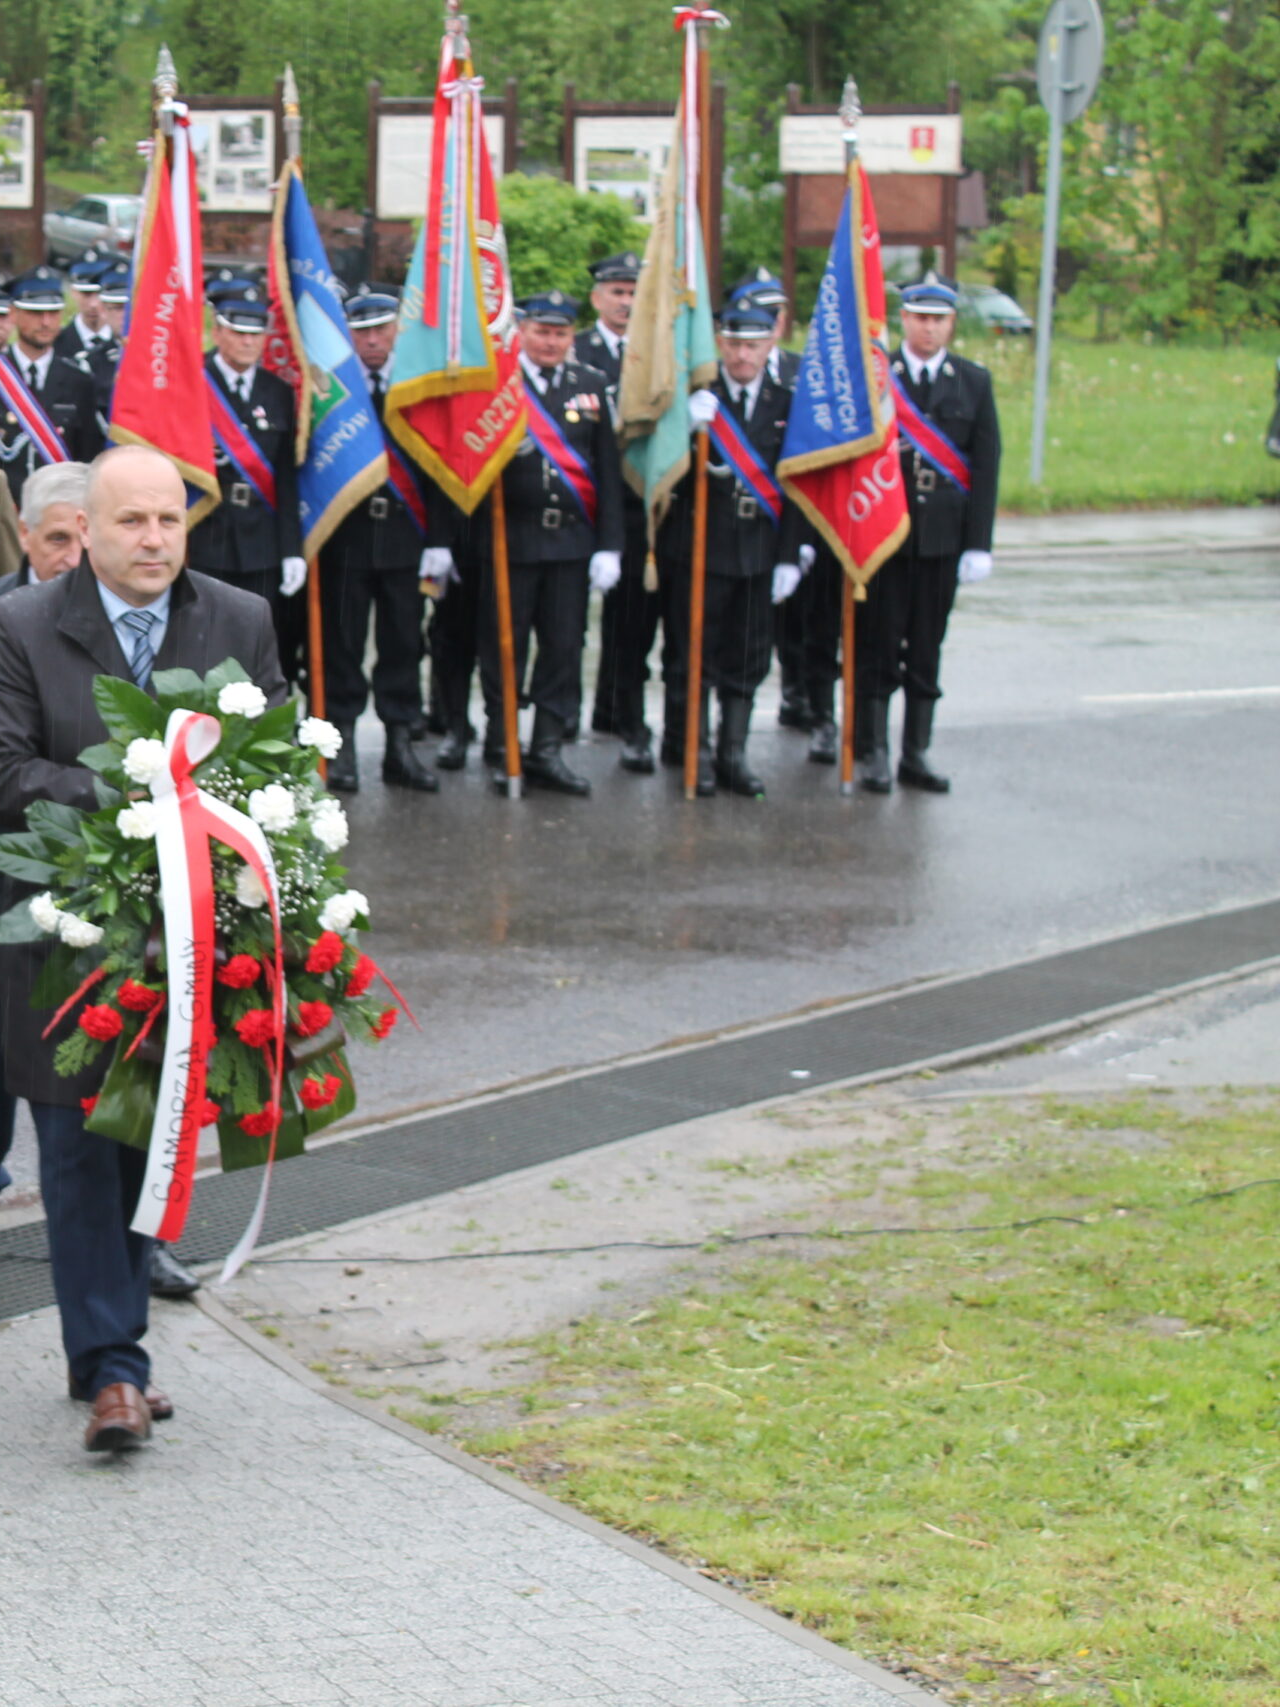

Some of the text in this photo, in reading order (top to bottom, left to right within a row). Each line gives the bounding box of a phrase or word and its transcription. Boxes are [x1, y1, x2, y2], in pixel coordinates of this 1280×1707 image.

[154, 292, 179, 324] NA
[150, 325, 170, 390] BOGU
[821, 271, 860, 435] OCHOTNICZYCH
[812, 402, 834, 432] RP
